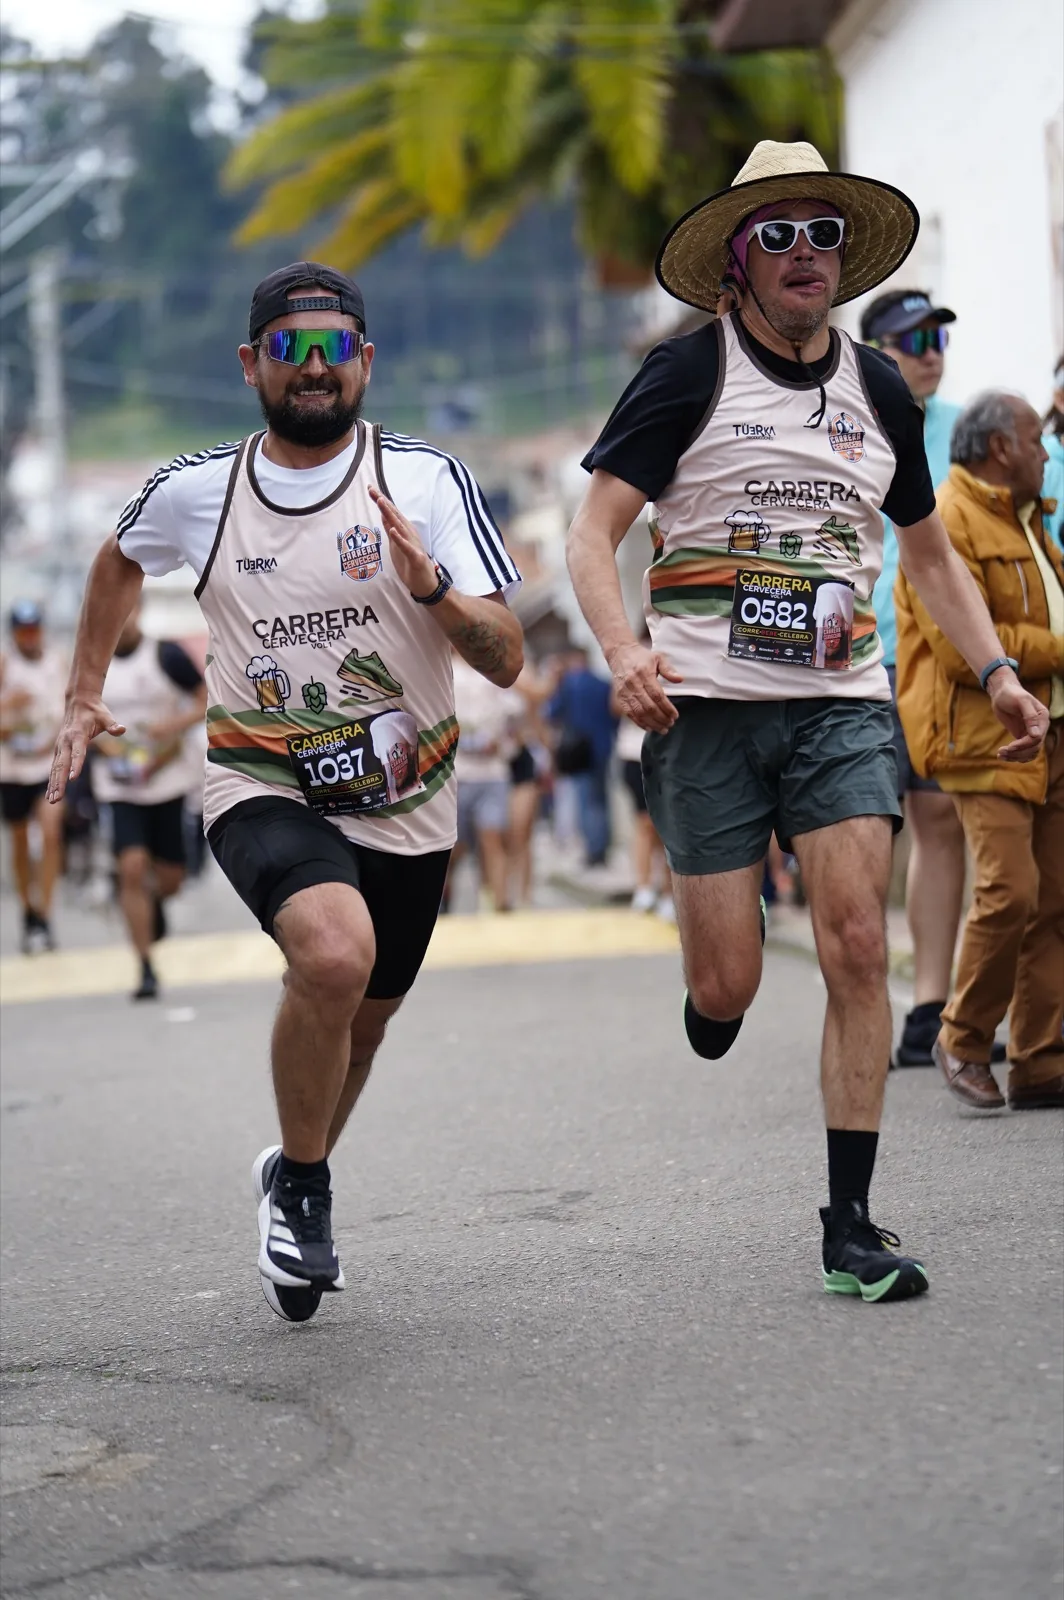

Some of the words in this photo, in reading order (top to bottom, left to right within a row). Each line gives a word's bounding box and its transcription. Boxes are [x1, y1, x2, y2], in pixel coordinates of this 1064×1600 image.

[744, 480, 861, 502] CARRERA
[751, 495, 831, 510] CERVECERA
[341, 544, 378, 563] CARRERA
[342, 552, 380, 570] CERVECERA
[740, 573, 812, 592] CARRERA
[743, 584, 792, 596] CERVECERA
[252, 605, 380, 640] CARRERA
[741, 597, 807, 630] 0582
[262, 629, 346, 649] CERVECERA
[291, 723, 365, 753] CARRERA
[297, 740, 347, 759] CERVECERA
[304, 748, 364, 787] 1037
[349, 776, 380, 789] CELEBRA
